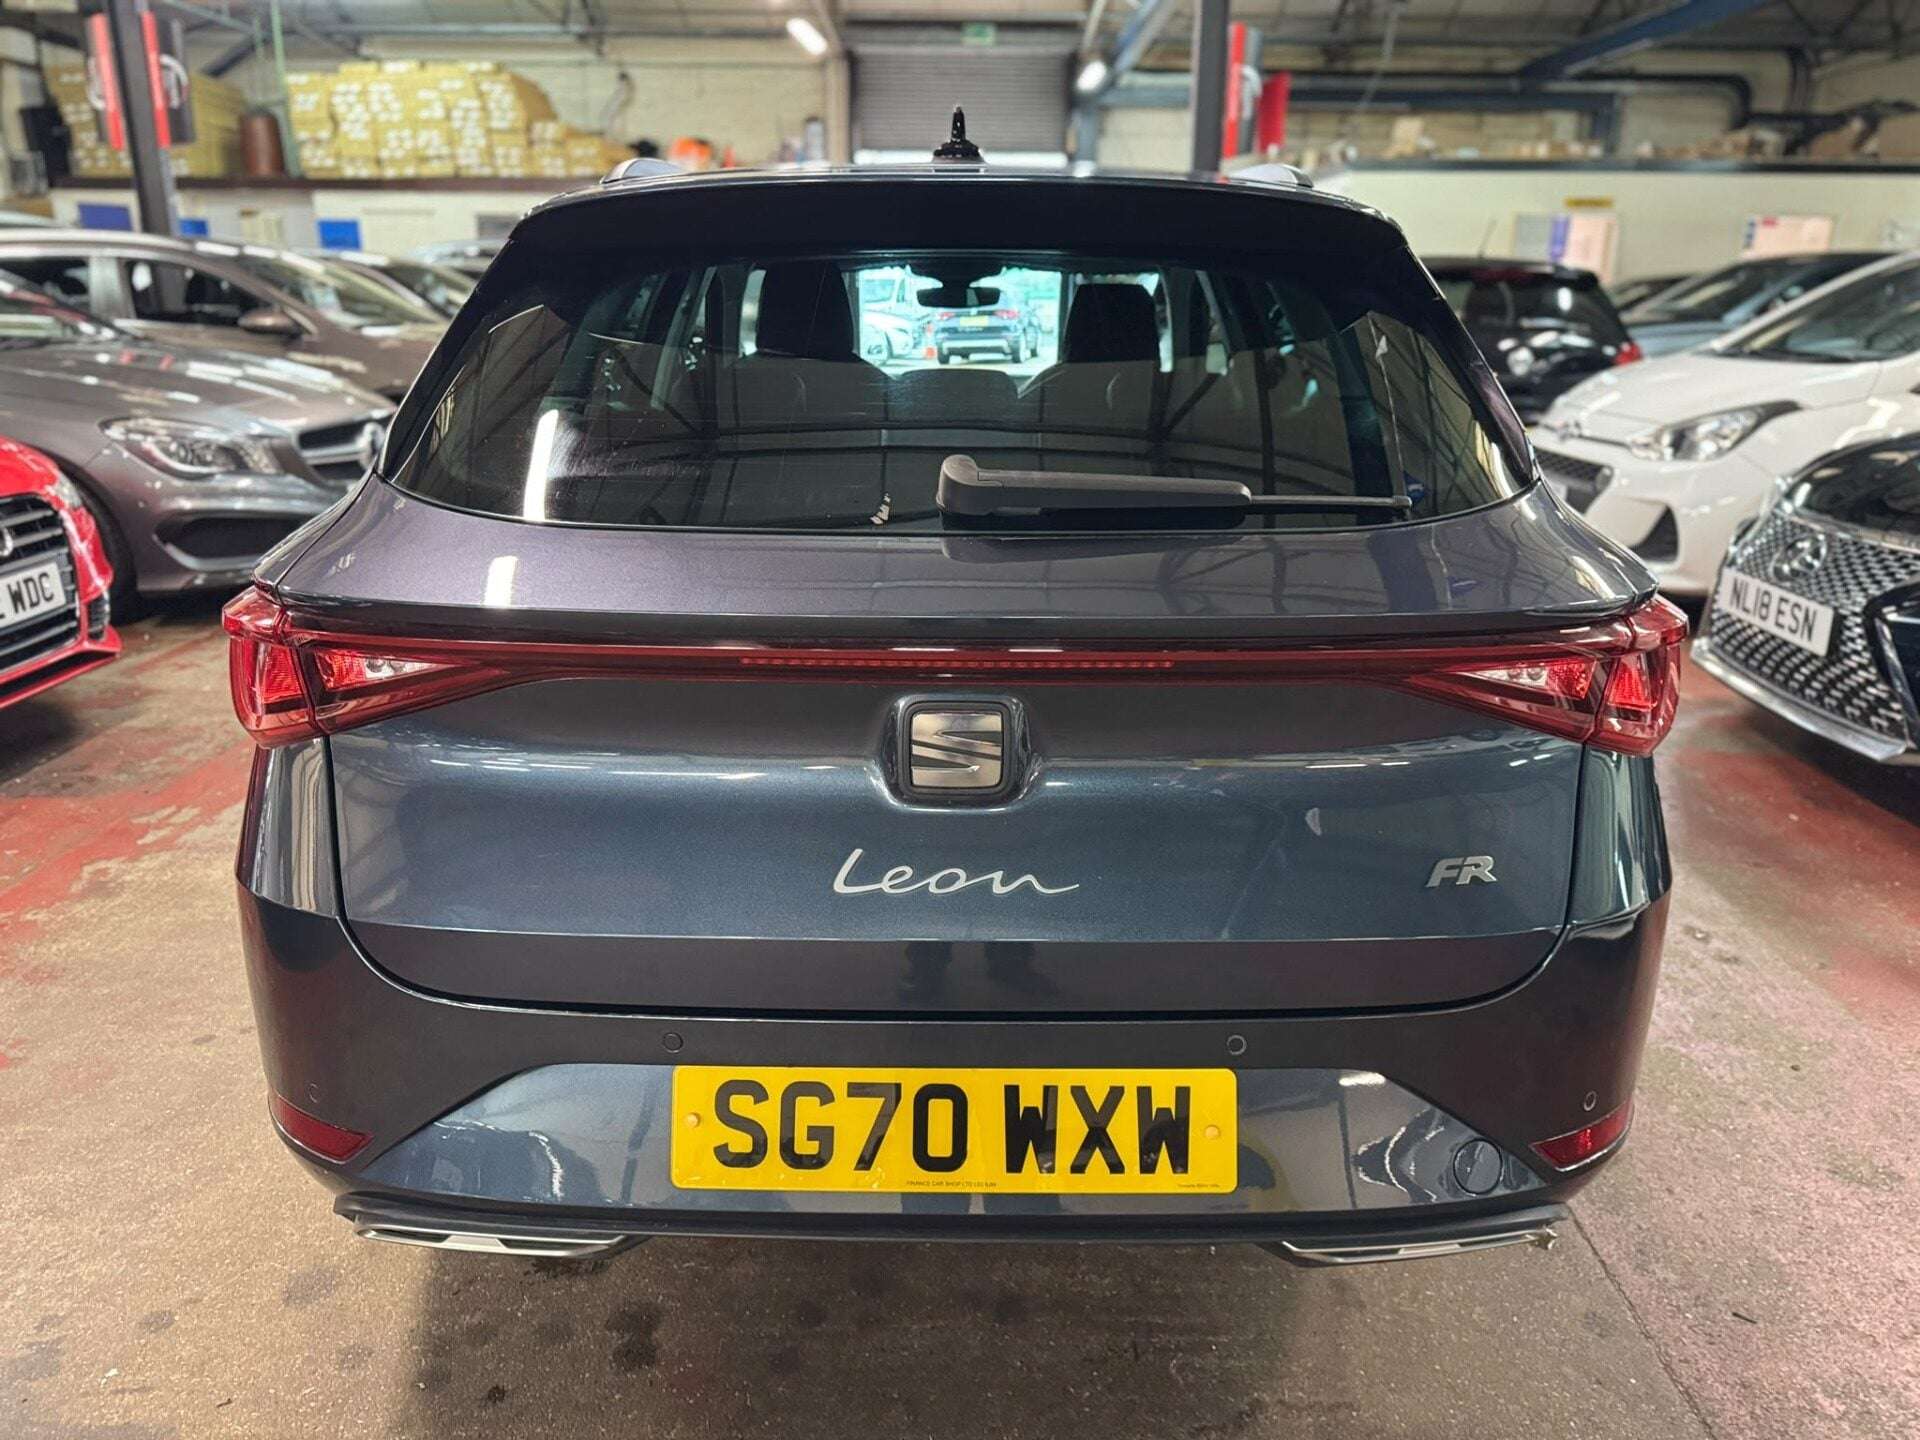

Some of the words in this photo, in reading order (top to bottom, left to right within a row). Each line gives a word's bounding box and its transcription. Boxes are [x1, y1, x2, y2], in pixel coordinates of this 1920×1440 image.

[7, 572, 55, 614] WDC
[1730, 577, 1772, 621] NL18
[1774, 596, 1818, 641] ESN
[833, 848, 1080, 894] Leon
[1424, 855, 1498, 888] FR
[713, 1079, 969, 1173] SG70
[1004, 1084, 1191, 1175] WXW
